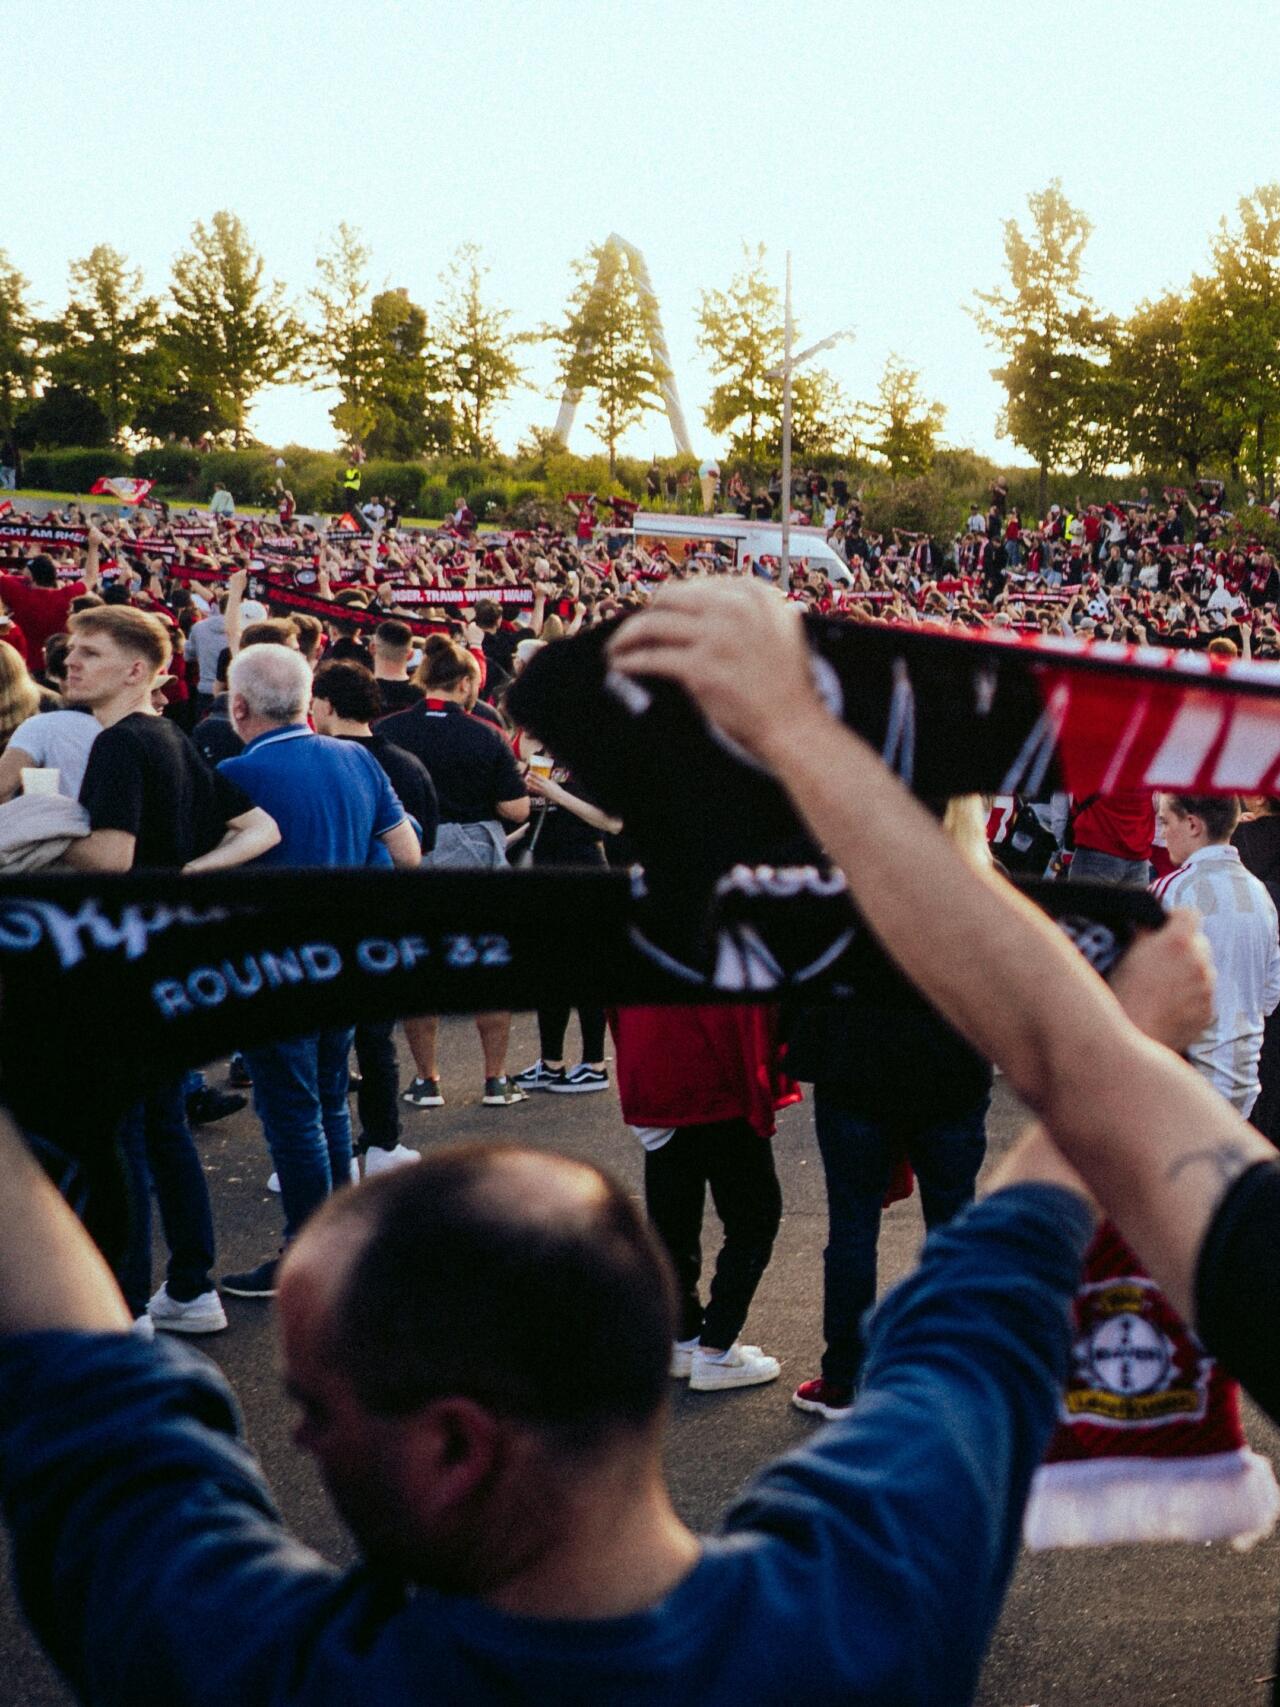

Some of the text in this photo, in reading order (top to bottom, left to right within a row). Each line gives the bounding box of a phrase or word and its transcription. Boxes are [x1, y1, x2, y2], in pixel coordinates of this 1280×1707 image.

[31, 529, 52, 542] AM
[425, 589, 463, 602] TRAUM
[152, 933, 513, 1020] ROUND OF 32
